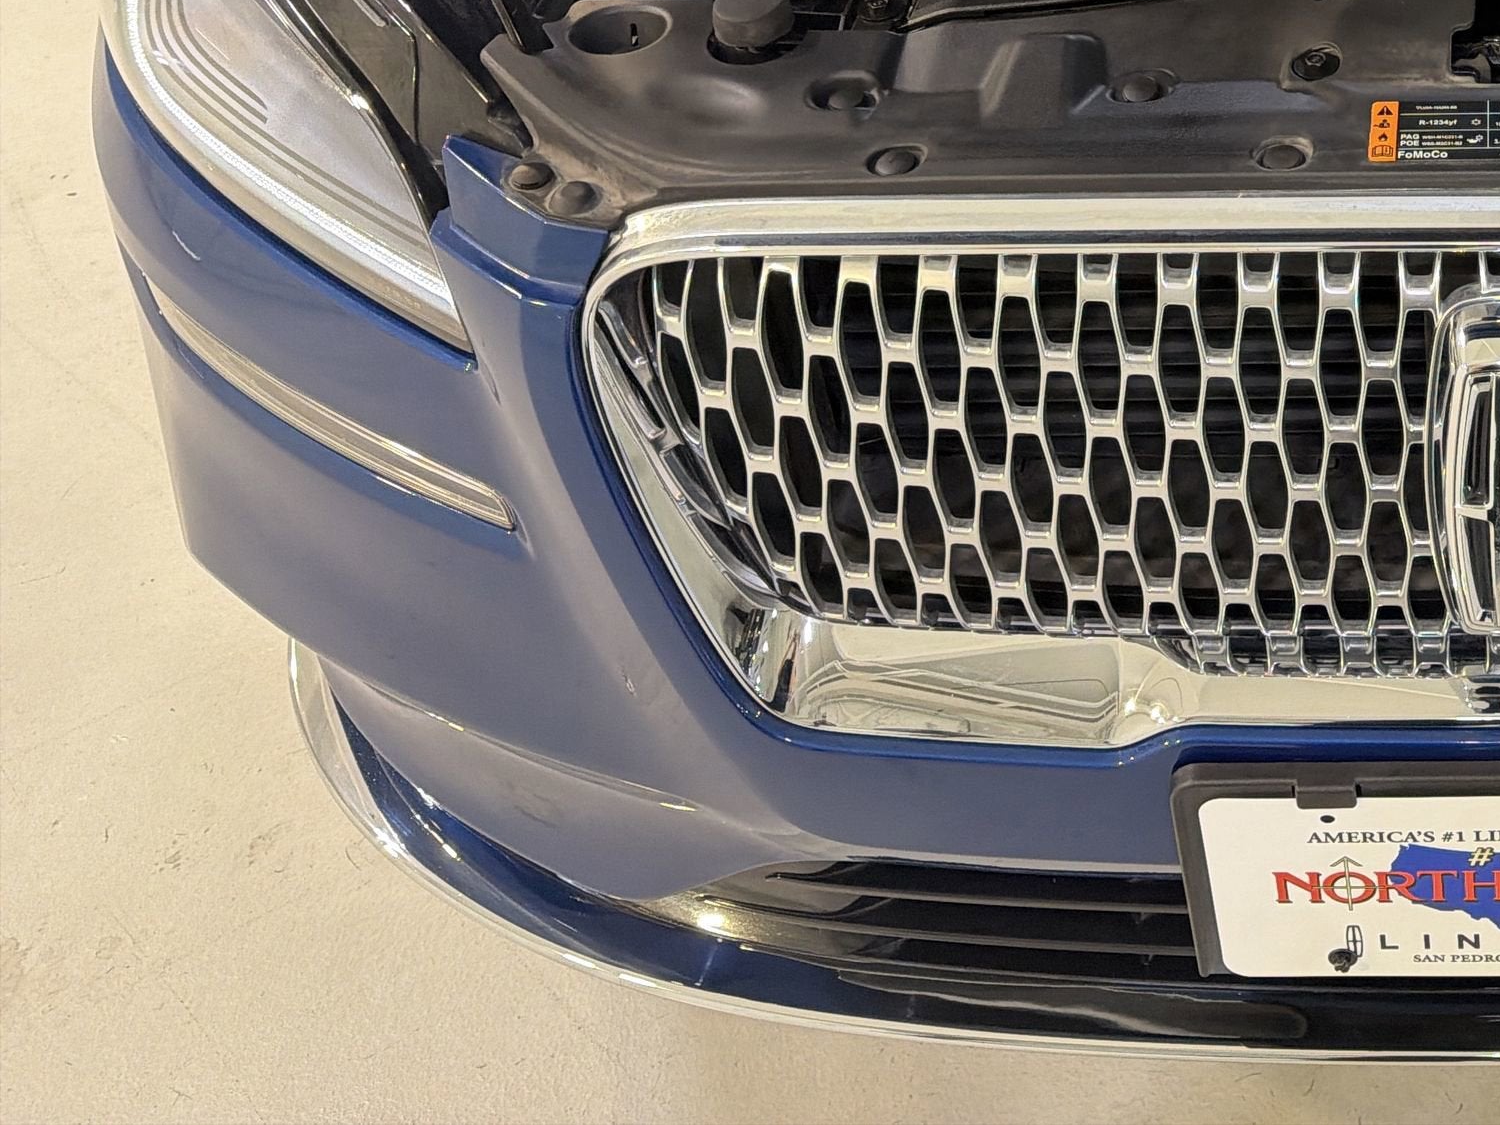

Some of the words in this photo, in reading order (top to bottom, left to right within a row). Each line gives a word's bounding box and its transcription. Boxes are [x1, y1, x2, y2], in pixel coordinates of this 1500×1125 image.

[1400, 139, 1420, 147] POE
[1397, 150, 1448, 159] FoMoCo
[1306, 830, 1436, 844] AMERICA'S
[1441, 830, 1465, 843] #1
[1413, 953, 1446, 963] SAN
